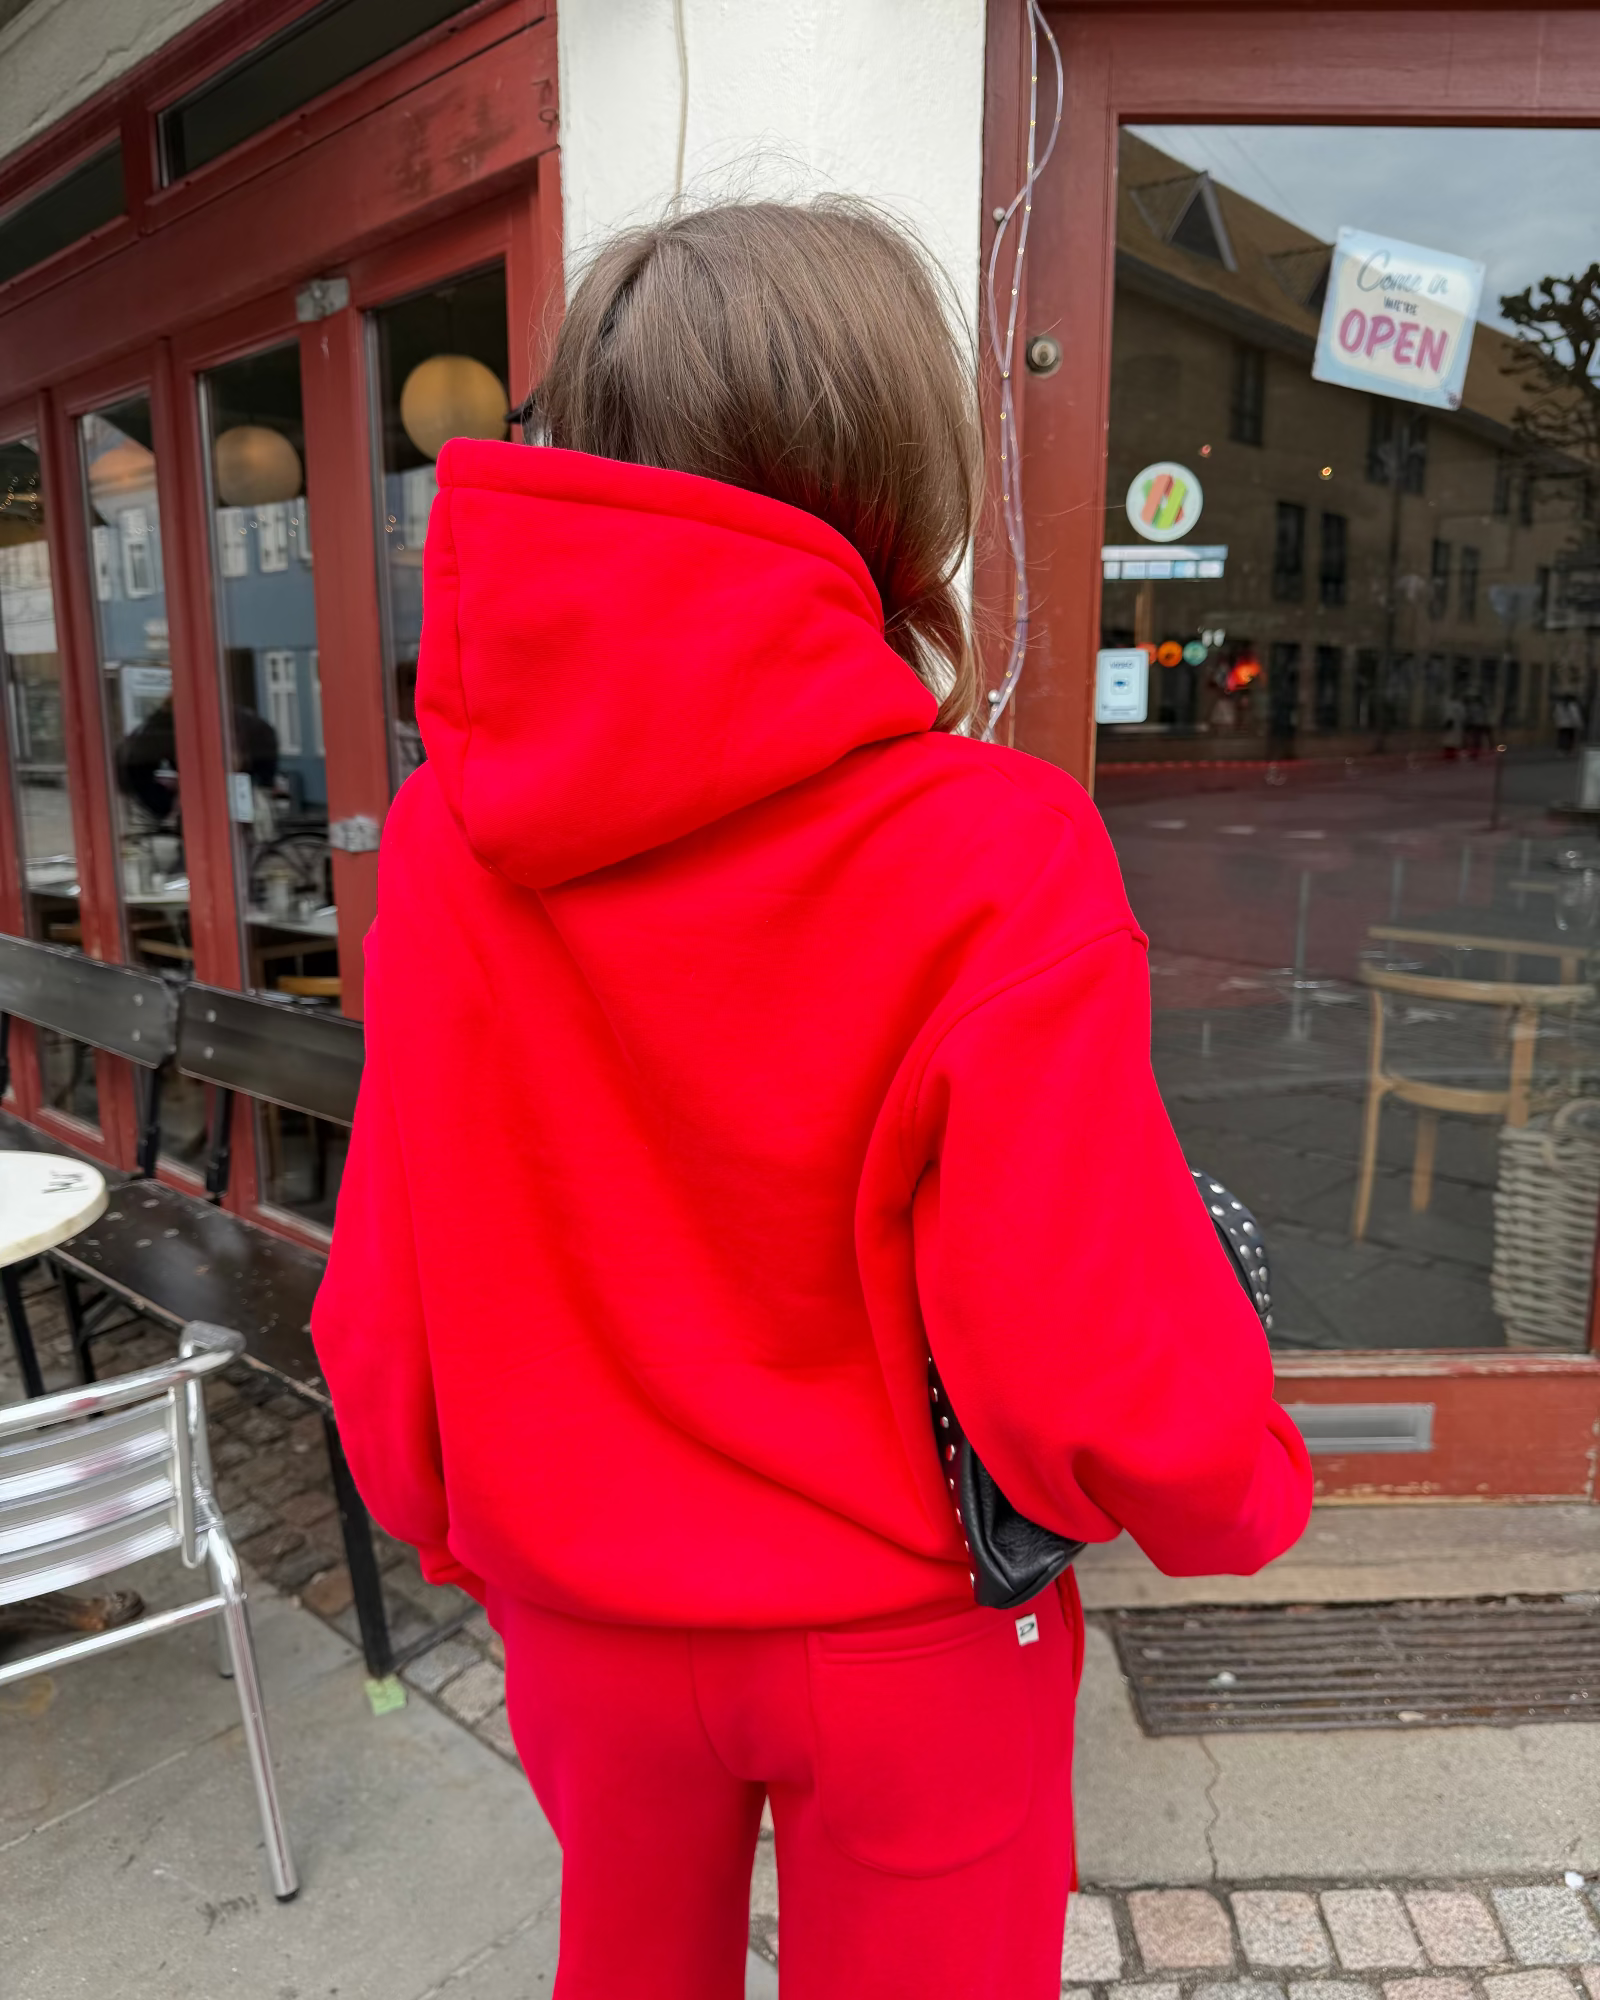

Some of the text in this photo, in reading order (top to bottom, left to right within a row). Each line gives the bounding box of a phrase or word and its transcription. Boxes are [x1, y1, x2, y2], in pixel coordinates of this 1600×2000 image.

[1357, 250, 1449, 295] Come in
[1338, 308, 1448, 373] OPEN
